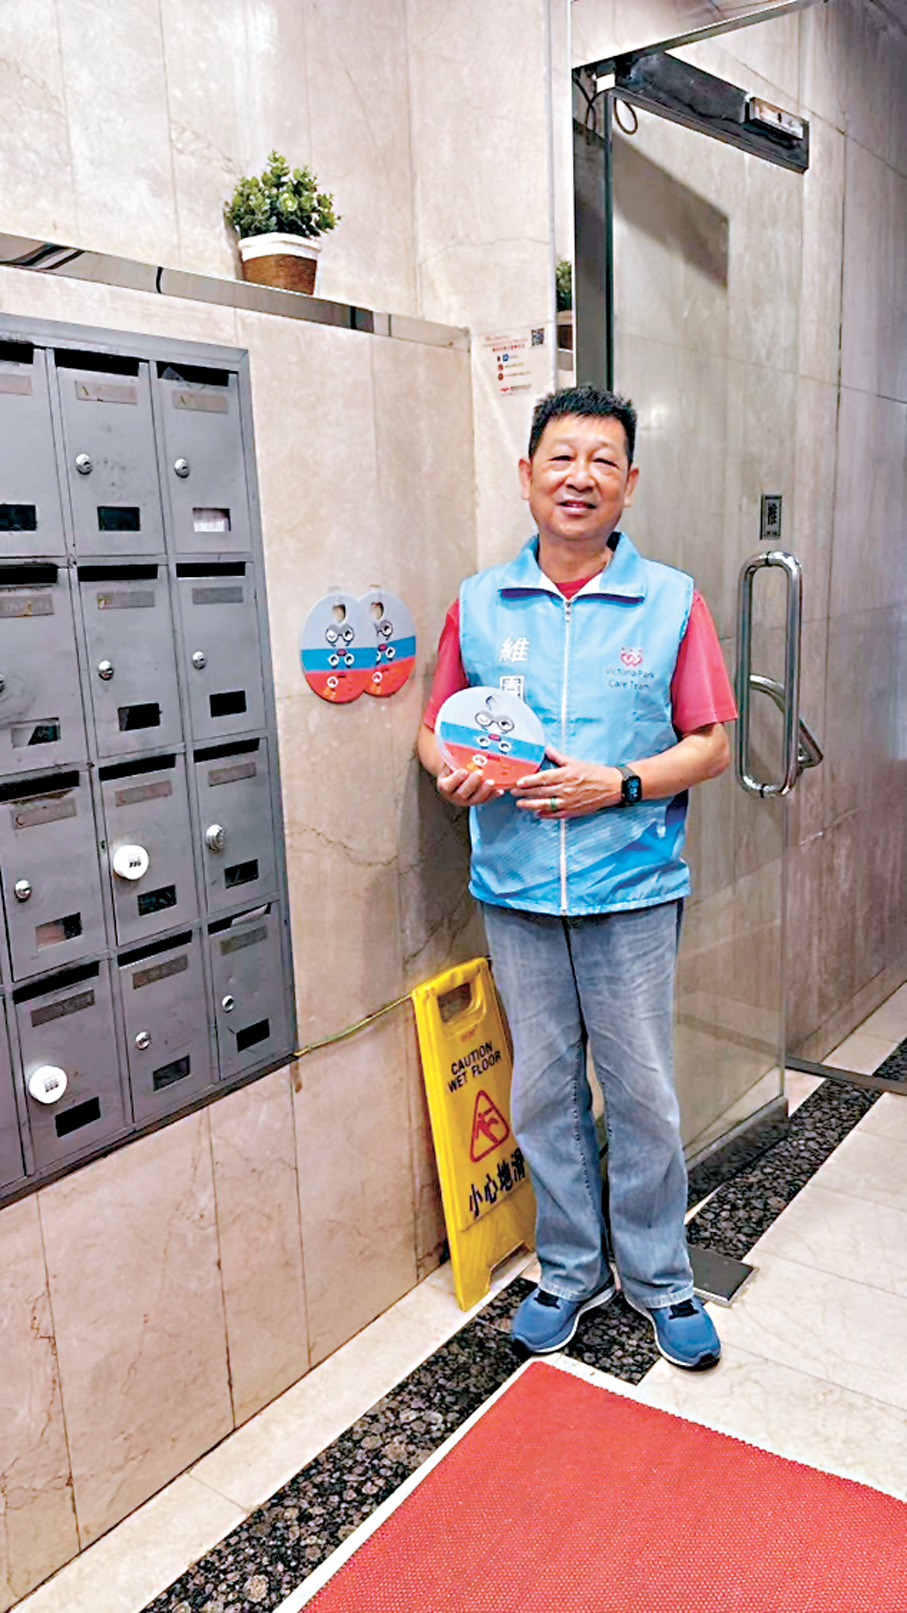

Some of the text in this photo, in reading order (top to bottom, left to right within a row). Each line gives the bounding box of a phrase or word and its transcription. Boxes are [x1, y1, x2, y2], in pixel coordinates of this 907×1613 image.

[608, 678, 650, 690] Care Team
[447, 1050, 502, 1093] WET FLOOR
[450, 1041, 493, 1075] CAUTION
[469, 1147, 525, 1220] 小心地滑
